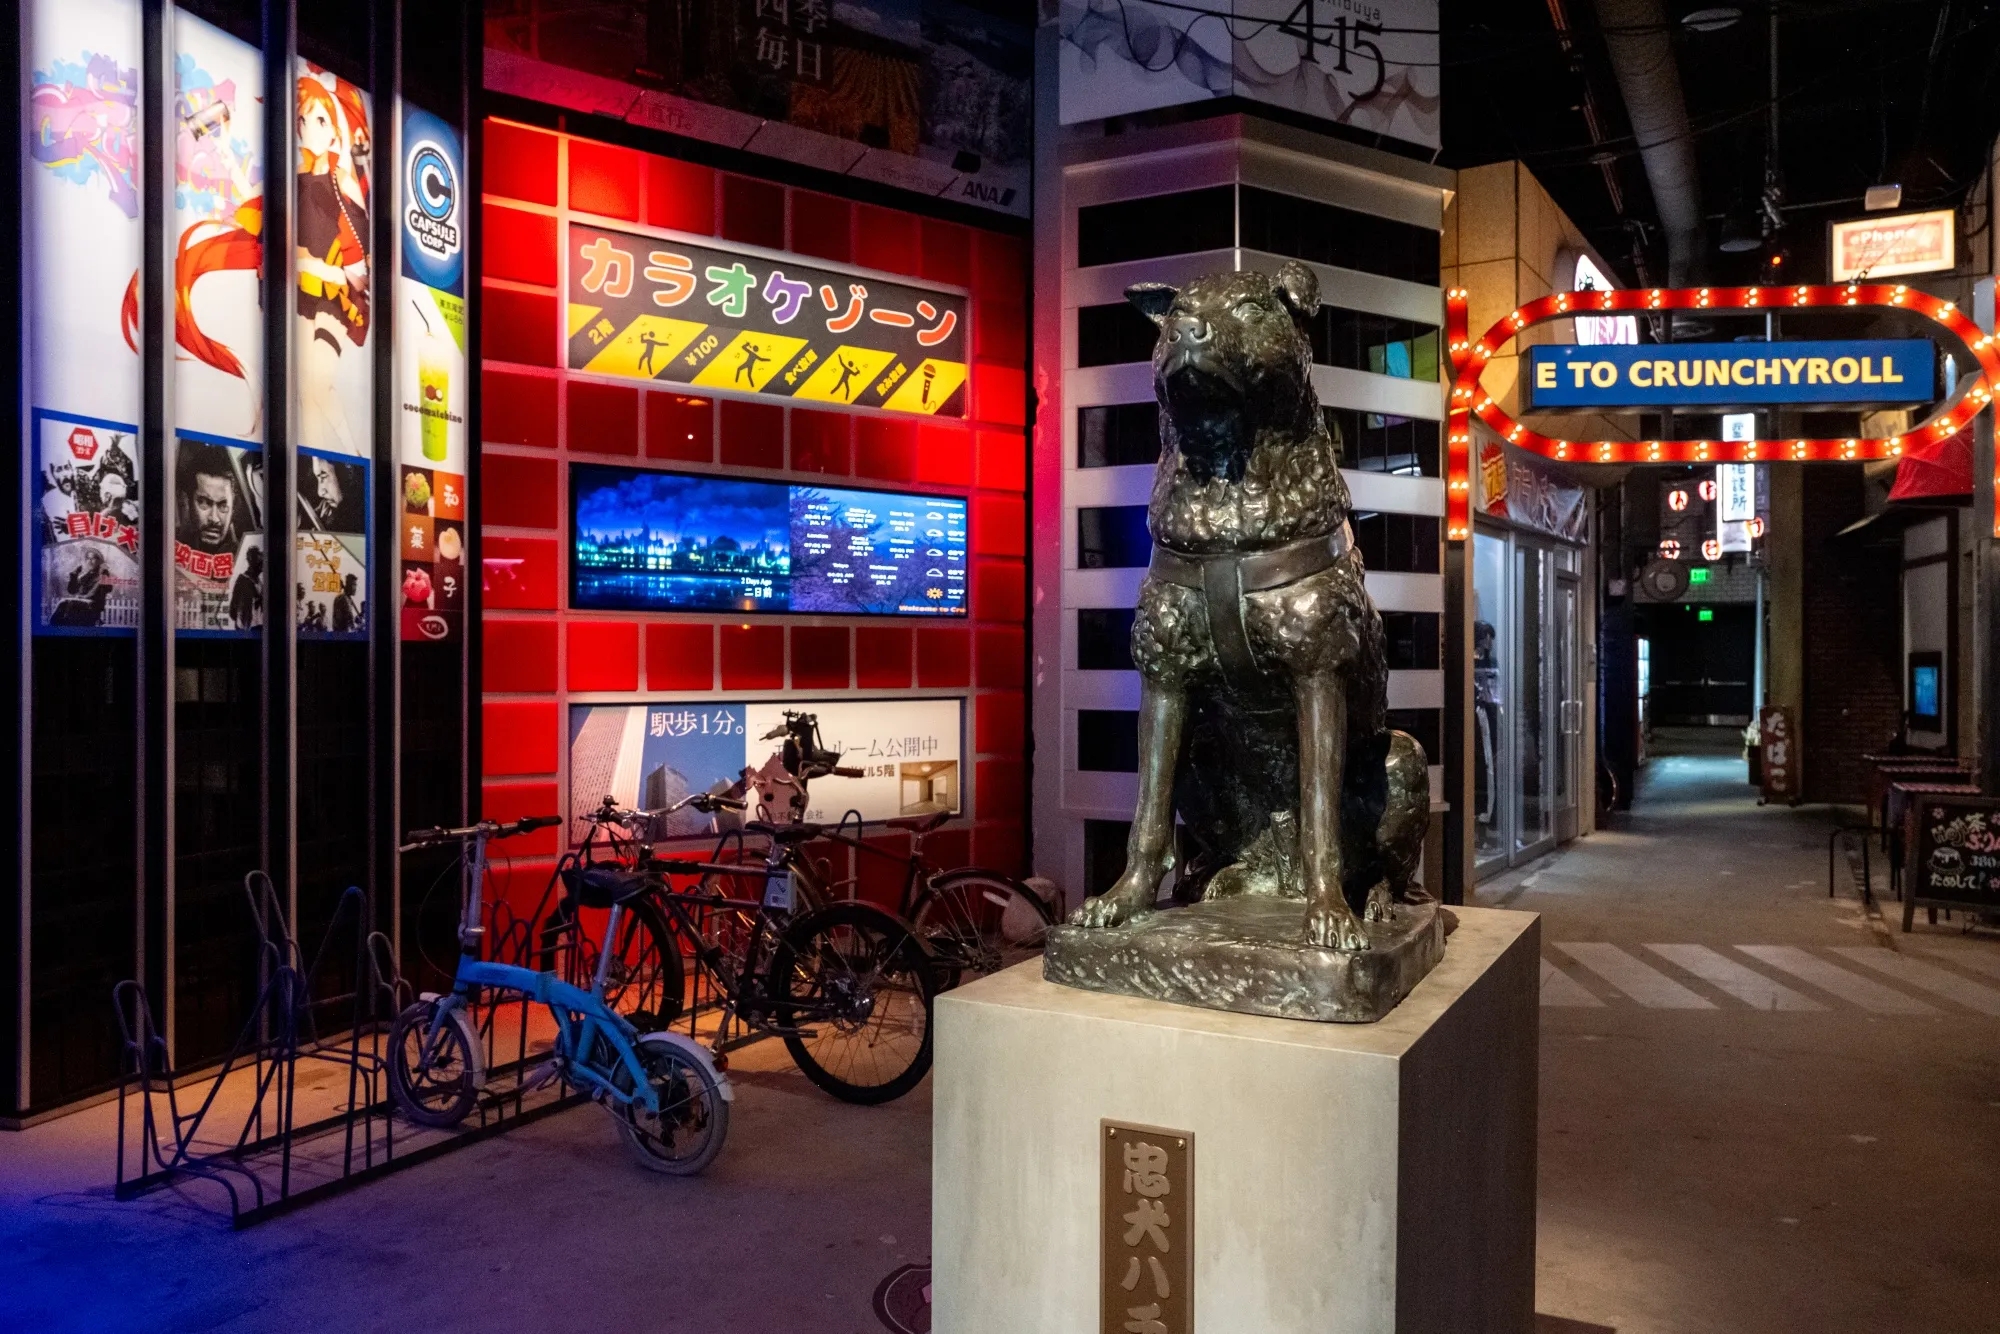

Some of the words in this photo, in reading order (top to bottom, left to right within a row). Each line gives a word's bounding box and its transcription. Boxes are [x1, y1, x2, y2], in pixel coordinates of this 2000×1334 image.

[1318, 0, 1381, 21] hibuya
[756, 26, 823, 81] 毎日
[961, 181, 999, 205] ANA
[410, 212, 457, 244] CAPSULE
[421, 233, 445, 252] CORP.
[579, 237, 958, 347] カラオケゾーン
[684, 335, 719, 367] ¥100
[1537, 362, 1557, 388] E
[1568, 360, 1619, 388] TO
[1628, 355, 1904, 388] CRUNCHYROLL
[312, 571, 342, 593] 公開
[743, 586, 773, 599] 二日前
[899, 605, 938, 613] Welcome
[650, 710, 744, 737] 駅歩1分。
[1765, 711, 1790, 793] たばこ
